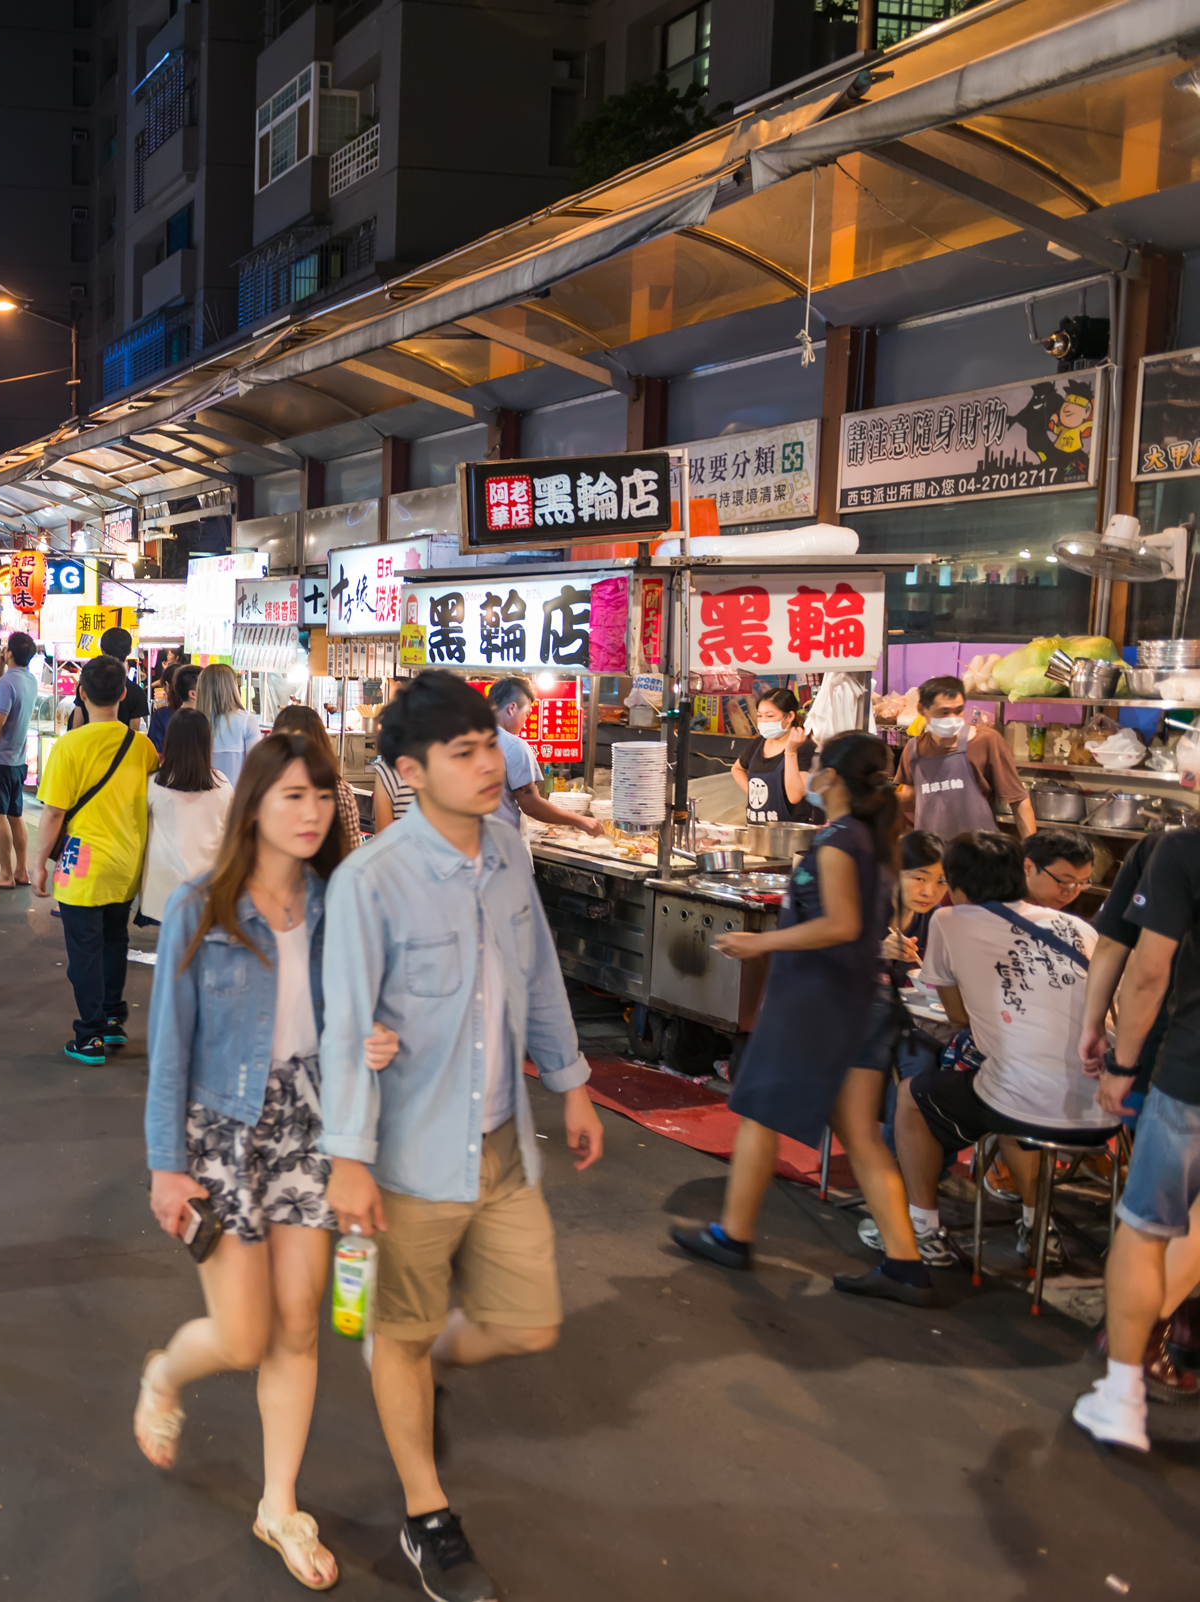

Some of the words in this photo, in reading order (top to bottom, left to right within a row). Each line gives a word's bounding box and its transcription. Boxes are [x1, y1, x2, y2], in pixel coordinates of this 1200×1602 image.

[847, 398, 1008, 467] 請注意隨身財物
[1062, 436, 1074, 448] 偷
[533, 468, 660, 527] 黑輪店
[847, 478, 955, 506] 西屯派出所關心您
[958, 467, 1059, 493] 04-27012717
[377, 557, 393, 578] 日式
[11, 569, 35, 607] 滷味
[464, 592, 482, 602] Oden
[526, 588, 543, 600] おでん
[79, 612, 106, 632] 滷味
[264, 601, 298, 622] 精緻香腸
[429, 585, 591, 669] 黑輪店
[644, 590, 658, 656] 開工大吉
[698, 582, 866, 667] 黑輪
